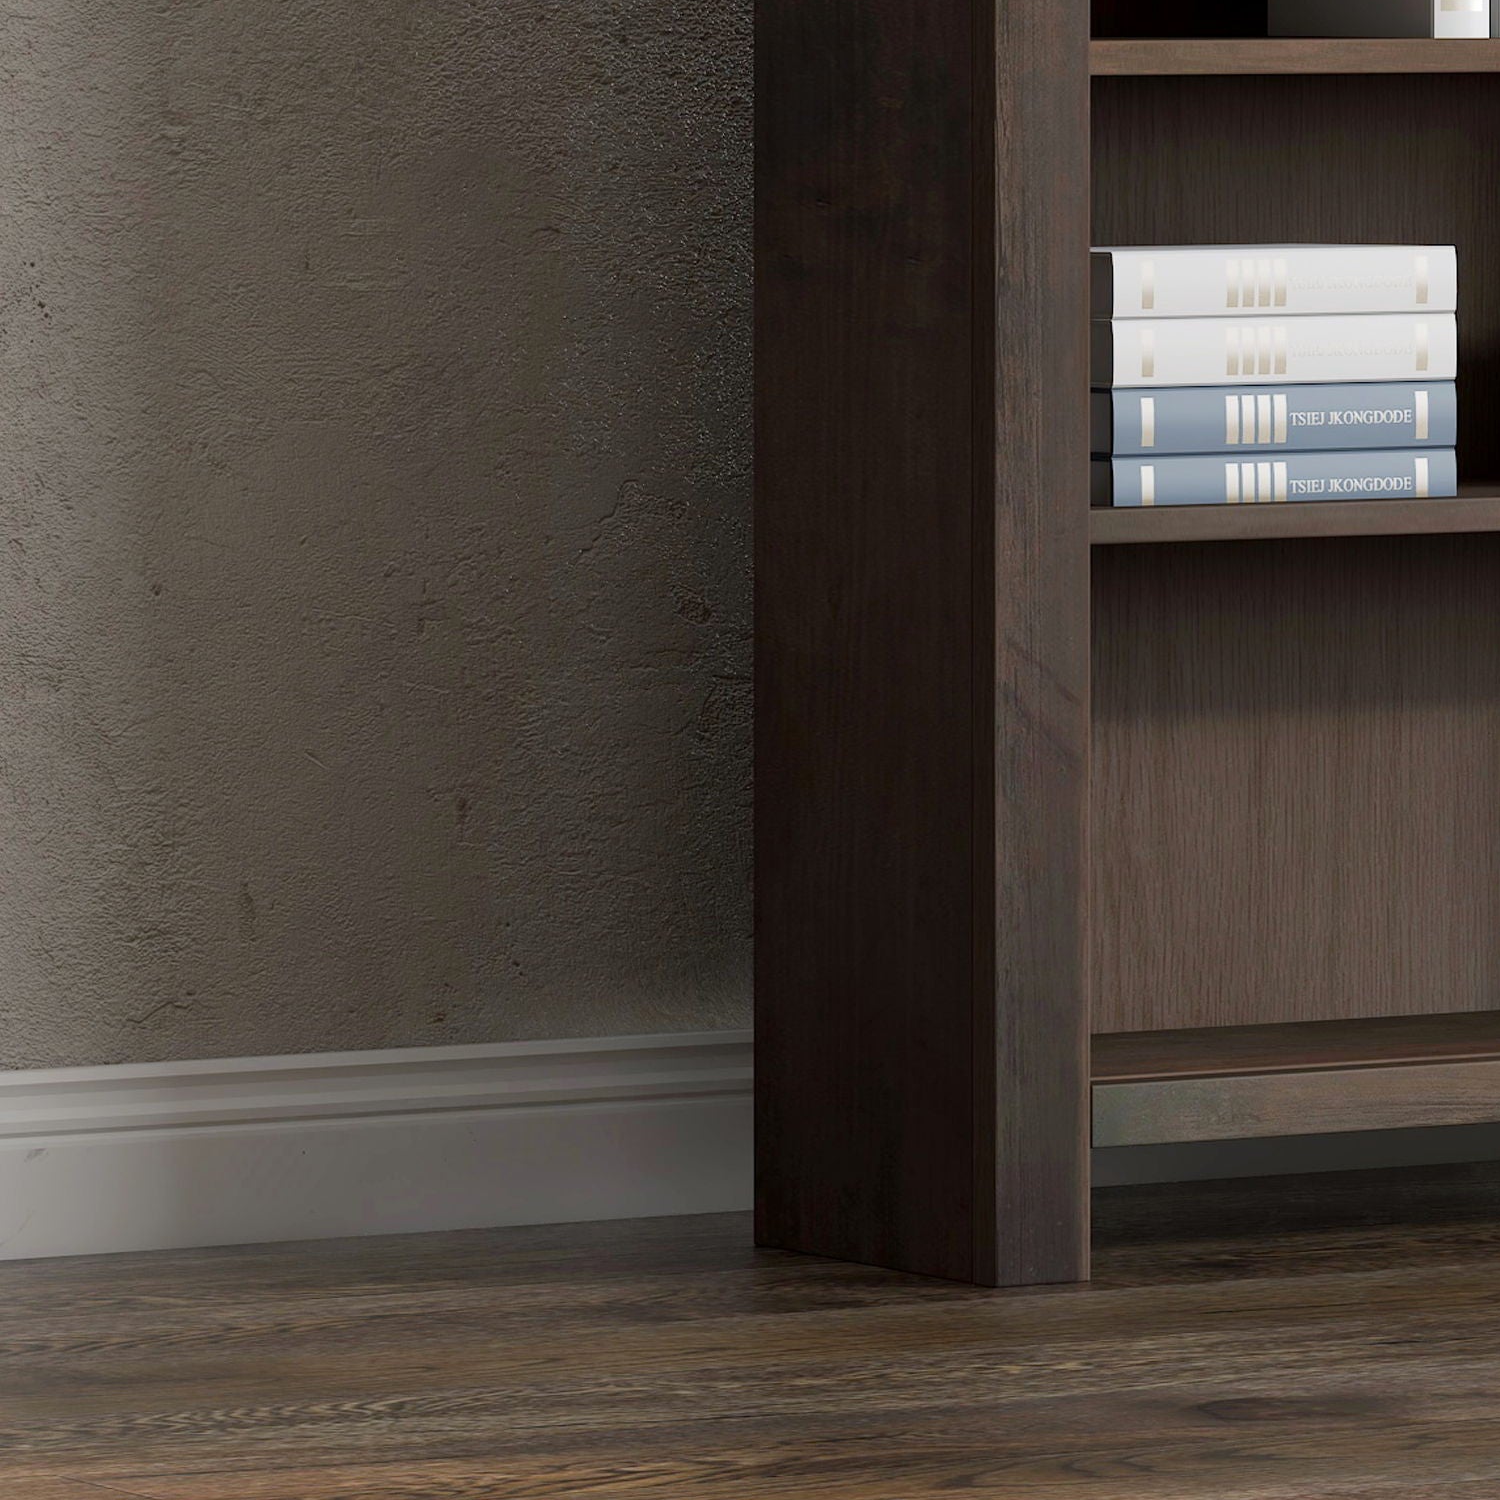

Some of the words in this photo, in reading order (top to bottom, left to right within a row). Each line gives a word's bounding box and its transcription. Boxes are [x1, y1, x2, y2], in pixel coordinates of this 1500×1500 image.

[1289, 411, 1324, 426] TSIEJ
[1327, 409, 1412, 425] JKONGDODE
[1289, 478, 1324, 494] TSIEJ
[1327, 476, 1412, 493] JKONGDODE
